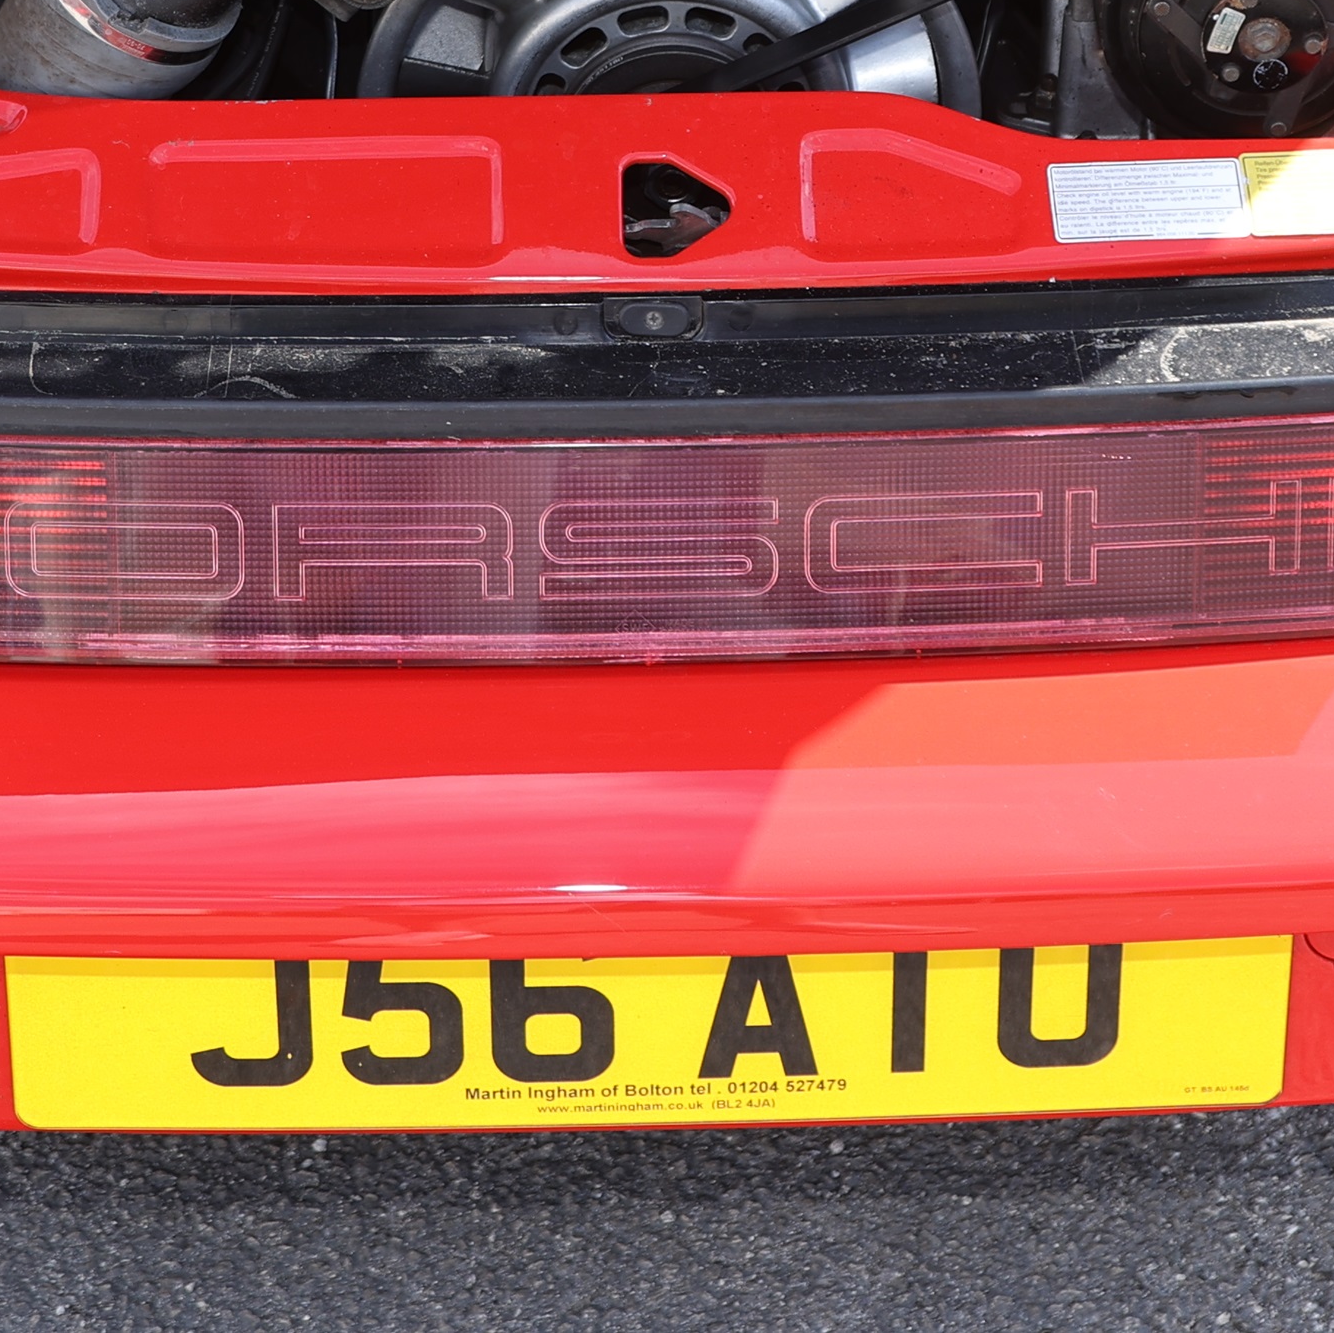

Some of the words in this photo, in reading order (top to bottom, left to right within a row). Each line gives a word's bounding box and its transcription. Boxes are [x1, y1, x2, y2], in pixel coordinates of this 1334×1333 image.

[190, 958, 615, 1087] J56
[464, 1086, 523, 1101] Martin
[528, 1085, 596, 1102] Ingham
[601, 1084, 619, 1098] of
[624, 1082, 684, 1098] Bolton
[727, 1081, 779, 1095] 01204
[785, 1079, 848, 1093] 527479
[537, 1099, 704, 1114] www.martiningham.co.uk
[711, 1098, 743, 1111] (BL2
[745, 1097, 776, 1110] 4JA)
